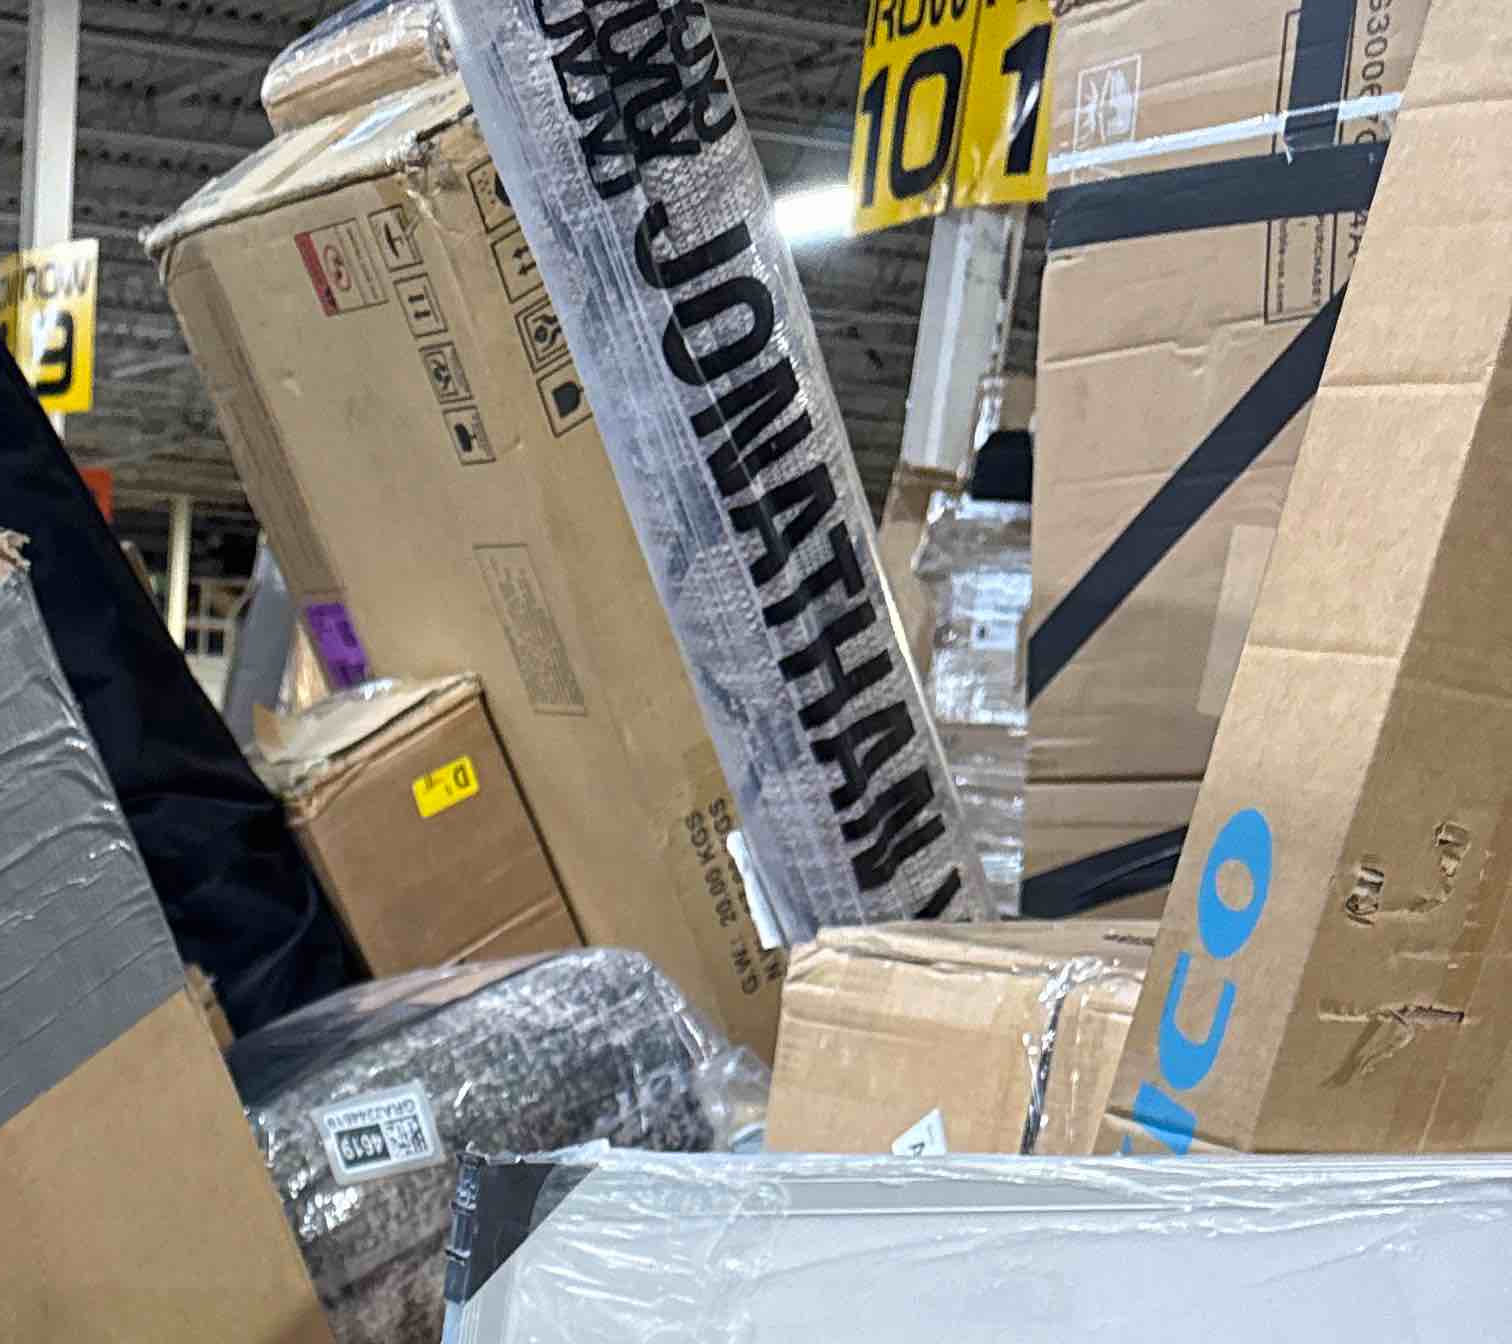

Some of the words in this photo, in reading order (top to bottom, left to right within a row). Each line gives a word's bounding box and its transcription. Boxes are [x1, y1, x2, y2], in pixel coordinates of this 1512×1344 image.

[861, 43, 963, 209] 10
[635, 200, 946, 893] JONATHAN
[1118, 808, 1273, 1154] ICO
